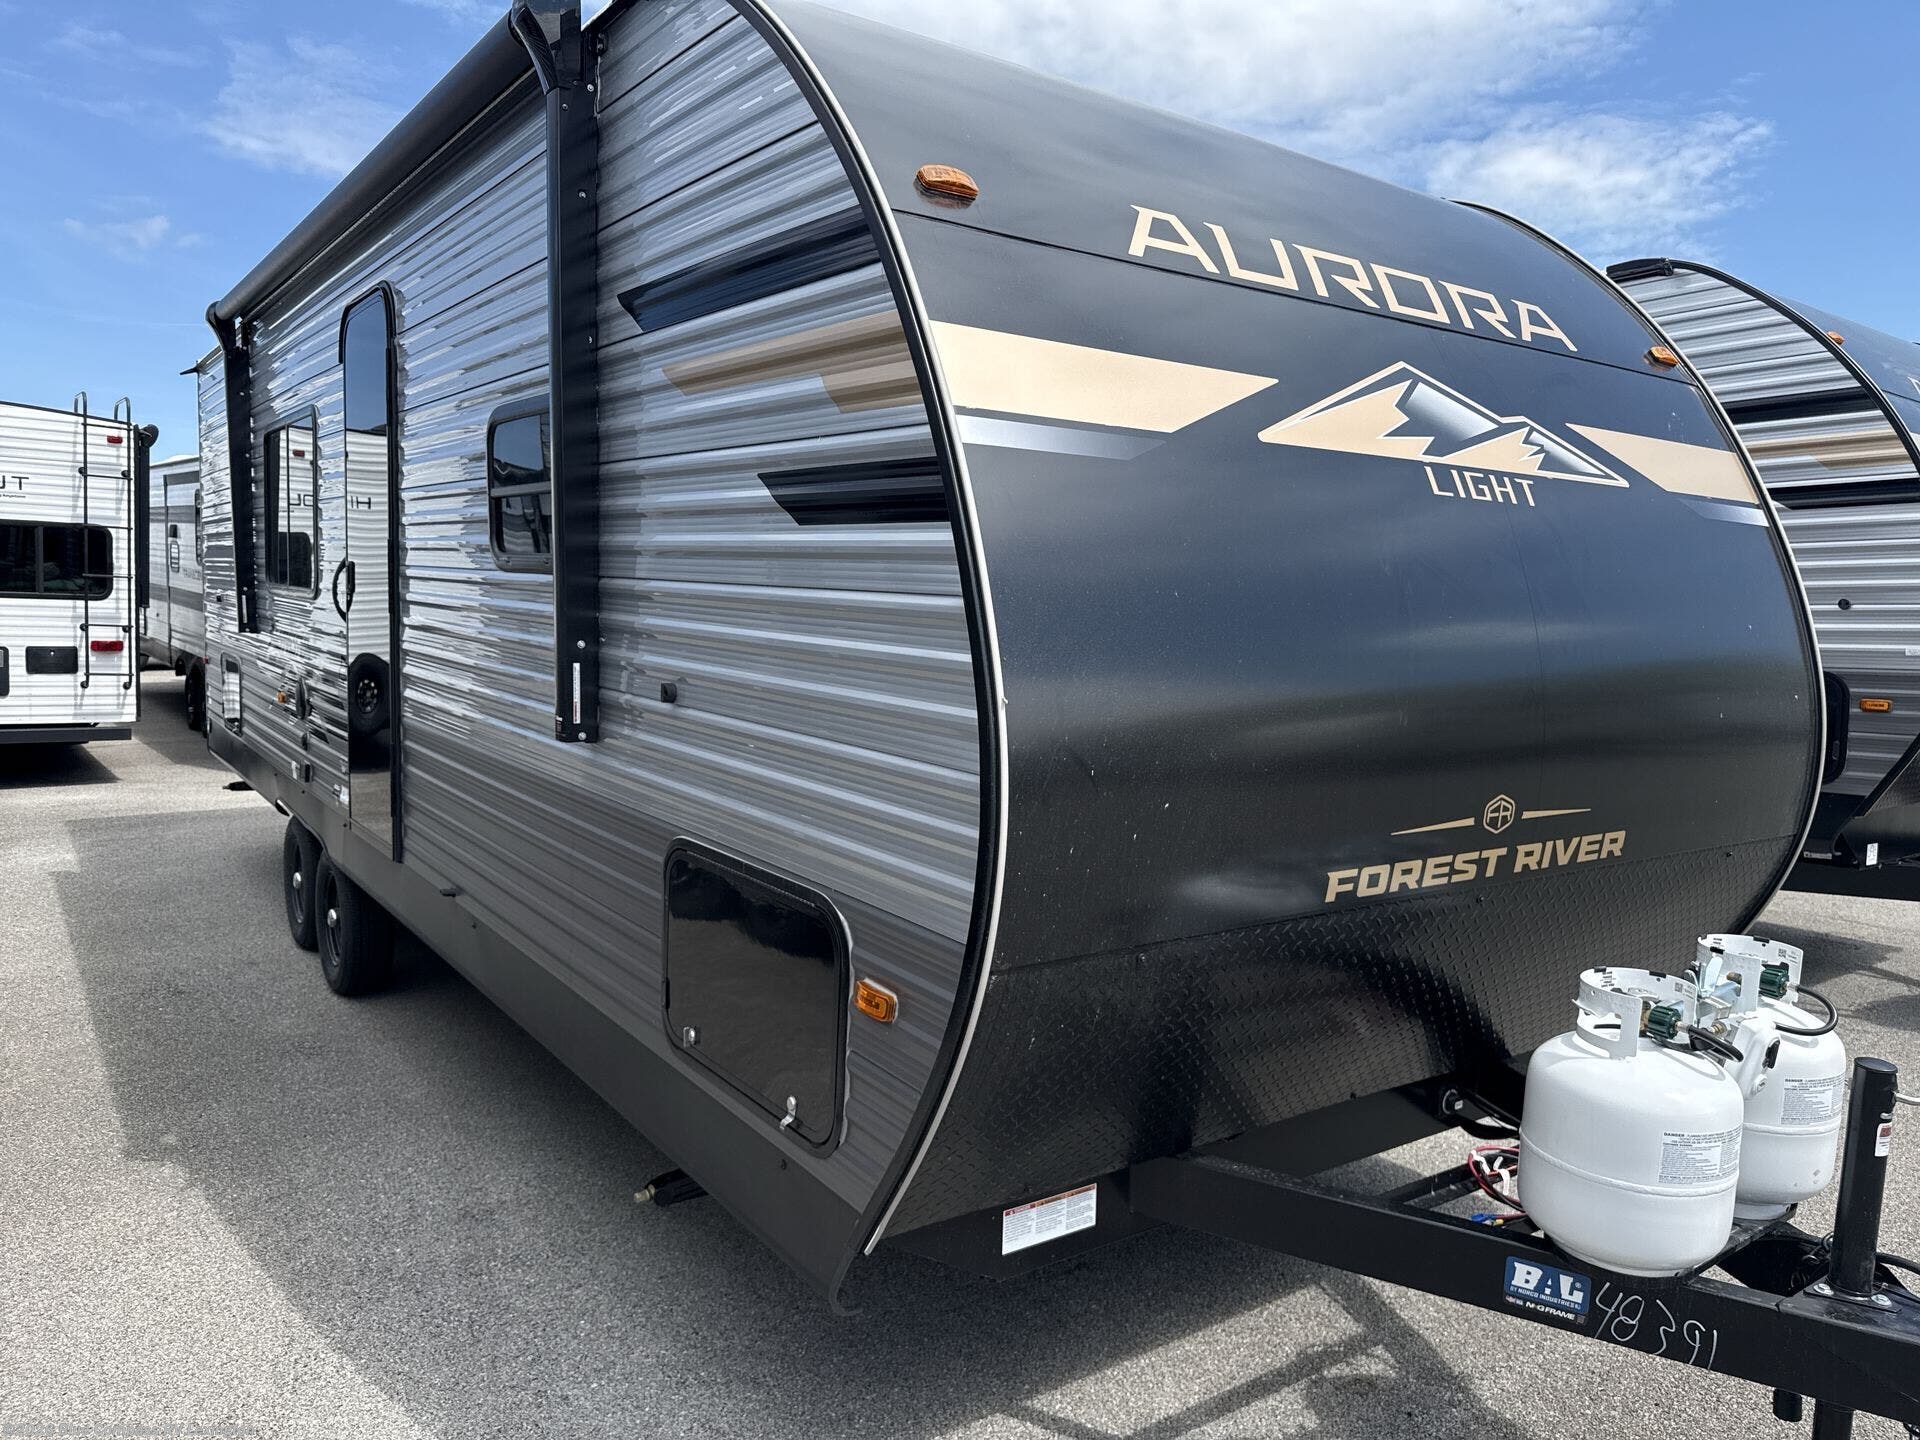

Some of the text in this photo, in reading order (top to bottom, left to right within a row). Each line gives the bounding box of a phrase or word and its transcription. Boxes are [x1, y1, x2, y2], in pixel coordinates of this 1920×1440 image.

[1127, 204, 1578, 352] AURORA
[1424, 466, 1535, 507] LIGHT
[1325, 830, 1626, 903] FOREST RIVER
[1518, 1288, 1539, 1299] NORCO
[1539, 1292, 1575, 1309] INDUSTRIES
[1544, 1305, 1576, 1321] FRAME
[1594, 1282, 1717, 1370] 48391
